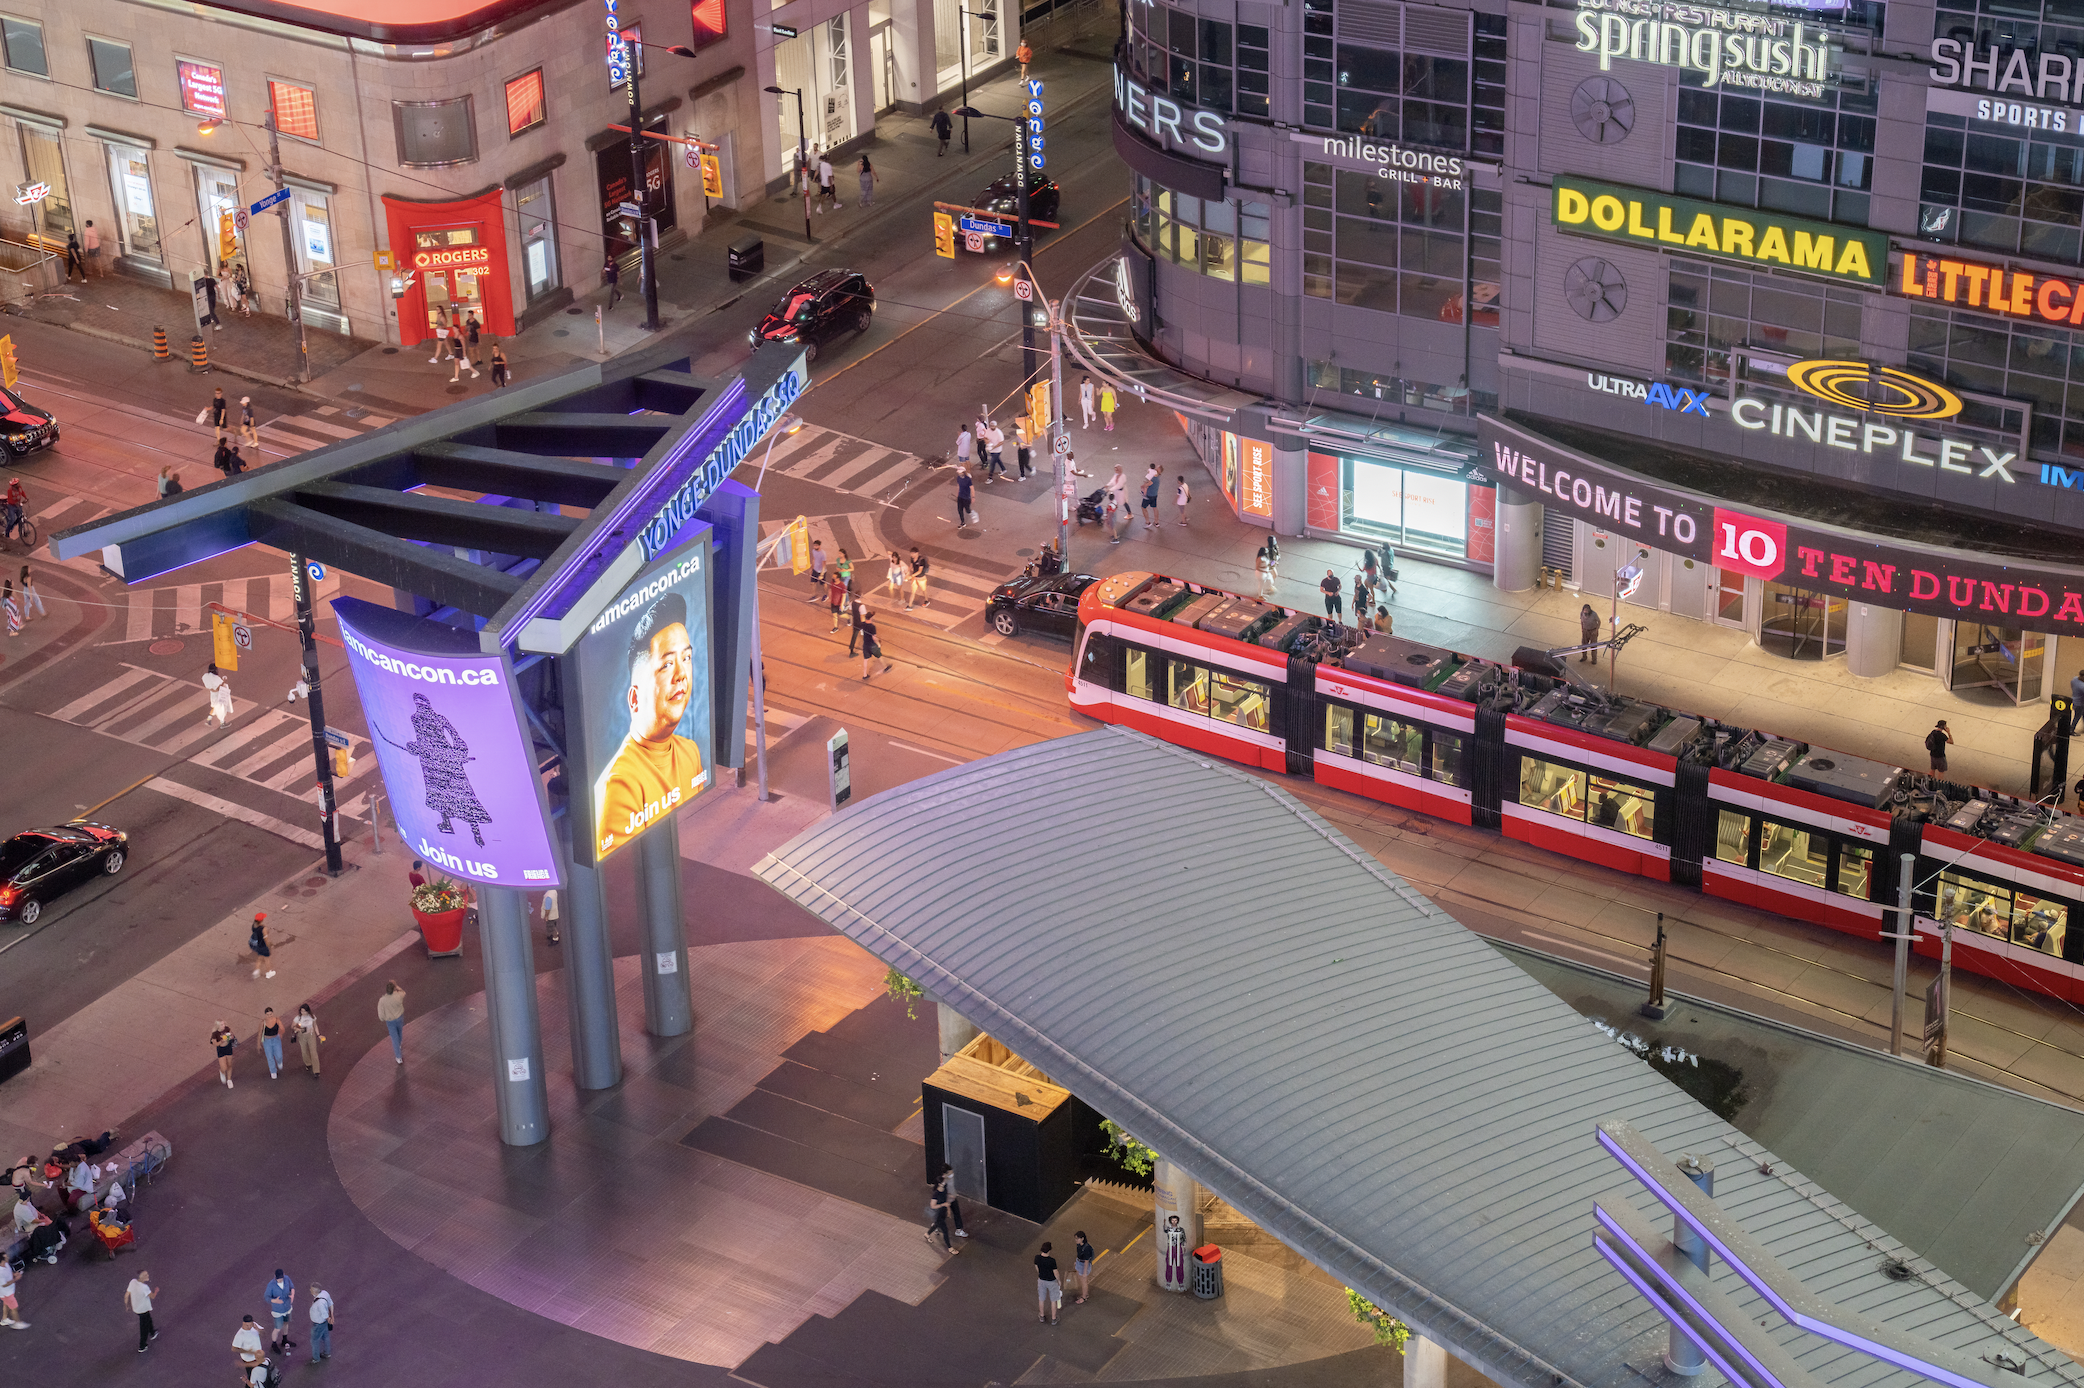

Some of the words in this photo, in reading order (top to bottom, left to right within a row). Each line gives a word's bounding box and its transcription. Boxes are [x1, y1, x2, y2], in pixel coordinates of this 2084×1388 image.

[1662, 2, 1789, 37] RESTAURANT
[187, 79, 213, 92] Largest
[624, 46, 634, 105] DOWNTOWN
[194, 91, 219, 104] Network
[1029, 80, 1043, 169] Yonge
[1977, 99, 2067, 132] SPORTS
[1015, 125, 1024, 187] DOWNTOWN
[1323, 136, 1462, 176] milestones
[646, 175, 660, 192] 5G
[1378, 167, 1418, 184] GRILL
[1433, 176, 1462, 190] BAR
[259, 195, 277, 209] Yonge
[970, 220, 997, 232] Dundas
[1557, 187, 1871, 278] DOLLARAMA
[432, 248, 489, 265] ROGERS
[472, 266, 490, 276] 302
[774, 370, 801, 414] SQ
[1731, 398, 2017, 484] CINEPLEX
[1253, 446, 1263, 466] RISE
[1253, 465, 1263, 493] SPORT
[1466, 474, 1487, 483] adidas
[2040, 463, 2084, 491] IM
[1253, 492, 1263, 508] SEE
[1392, 490, 1402, 499] SEE
[1404, 492, 1421, 502] SPORT
[1422, 497, 1435, 505] RISE
[1494, 441, 1642, 528] WELCOME
[1653, 505, 1697, 544] TO
[1720, 522, 1778, 567] 10
[1798, 545, 1897, 594] TEN
[1909, 569, 2084, 622] DUNDA
[339, 620, 499, 686] iamcancon.ca
[624, 801, 660, 834] Join
[661, 787, 681, 810] us
[418, 837, 464, 872] Join
[465, 859, 499, 879] us
[1655, 844, 1668, 852] 4511
